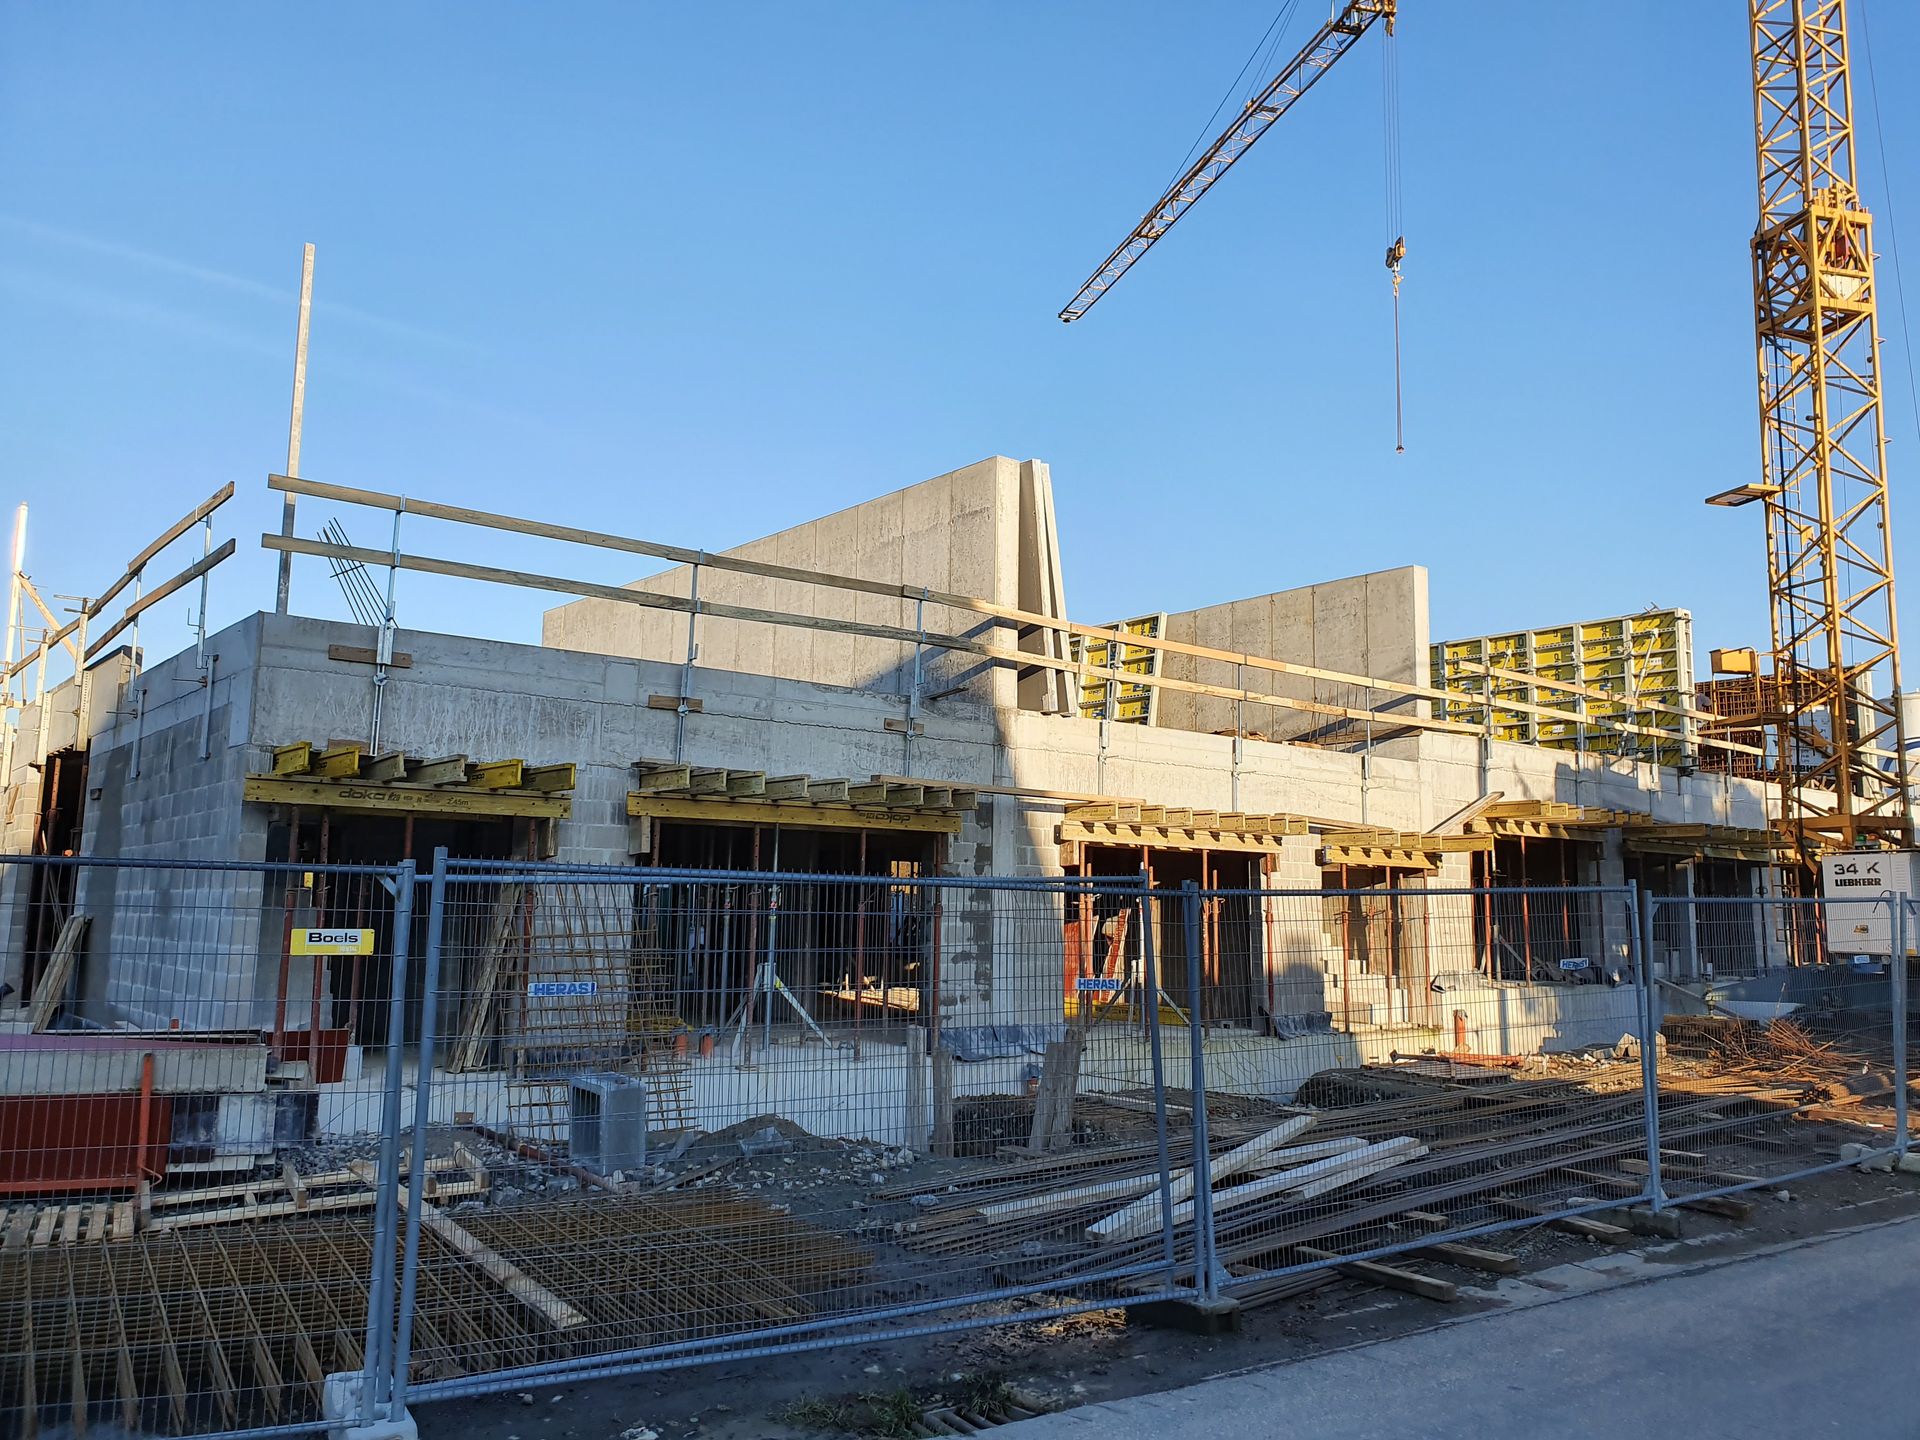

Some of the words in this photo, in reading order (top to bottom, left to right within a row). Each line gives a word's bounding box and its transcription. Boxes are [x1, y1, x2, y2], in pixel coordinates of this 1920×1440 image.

[339, 788, 387, 801] doka
[1834, 863, 1859, 875] 34
[1866, 861, 1881, 874] K
[1835, 878, 1882, 887] LIEBHERR
[308, 932, 359, 943] Boels
[534, 983, 589, 996] HERAS
